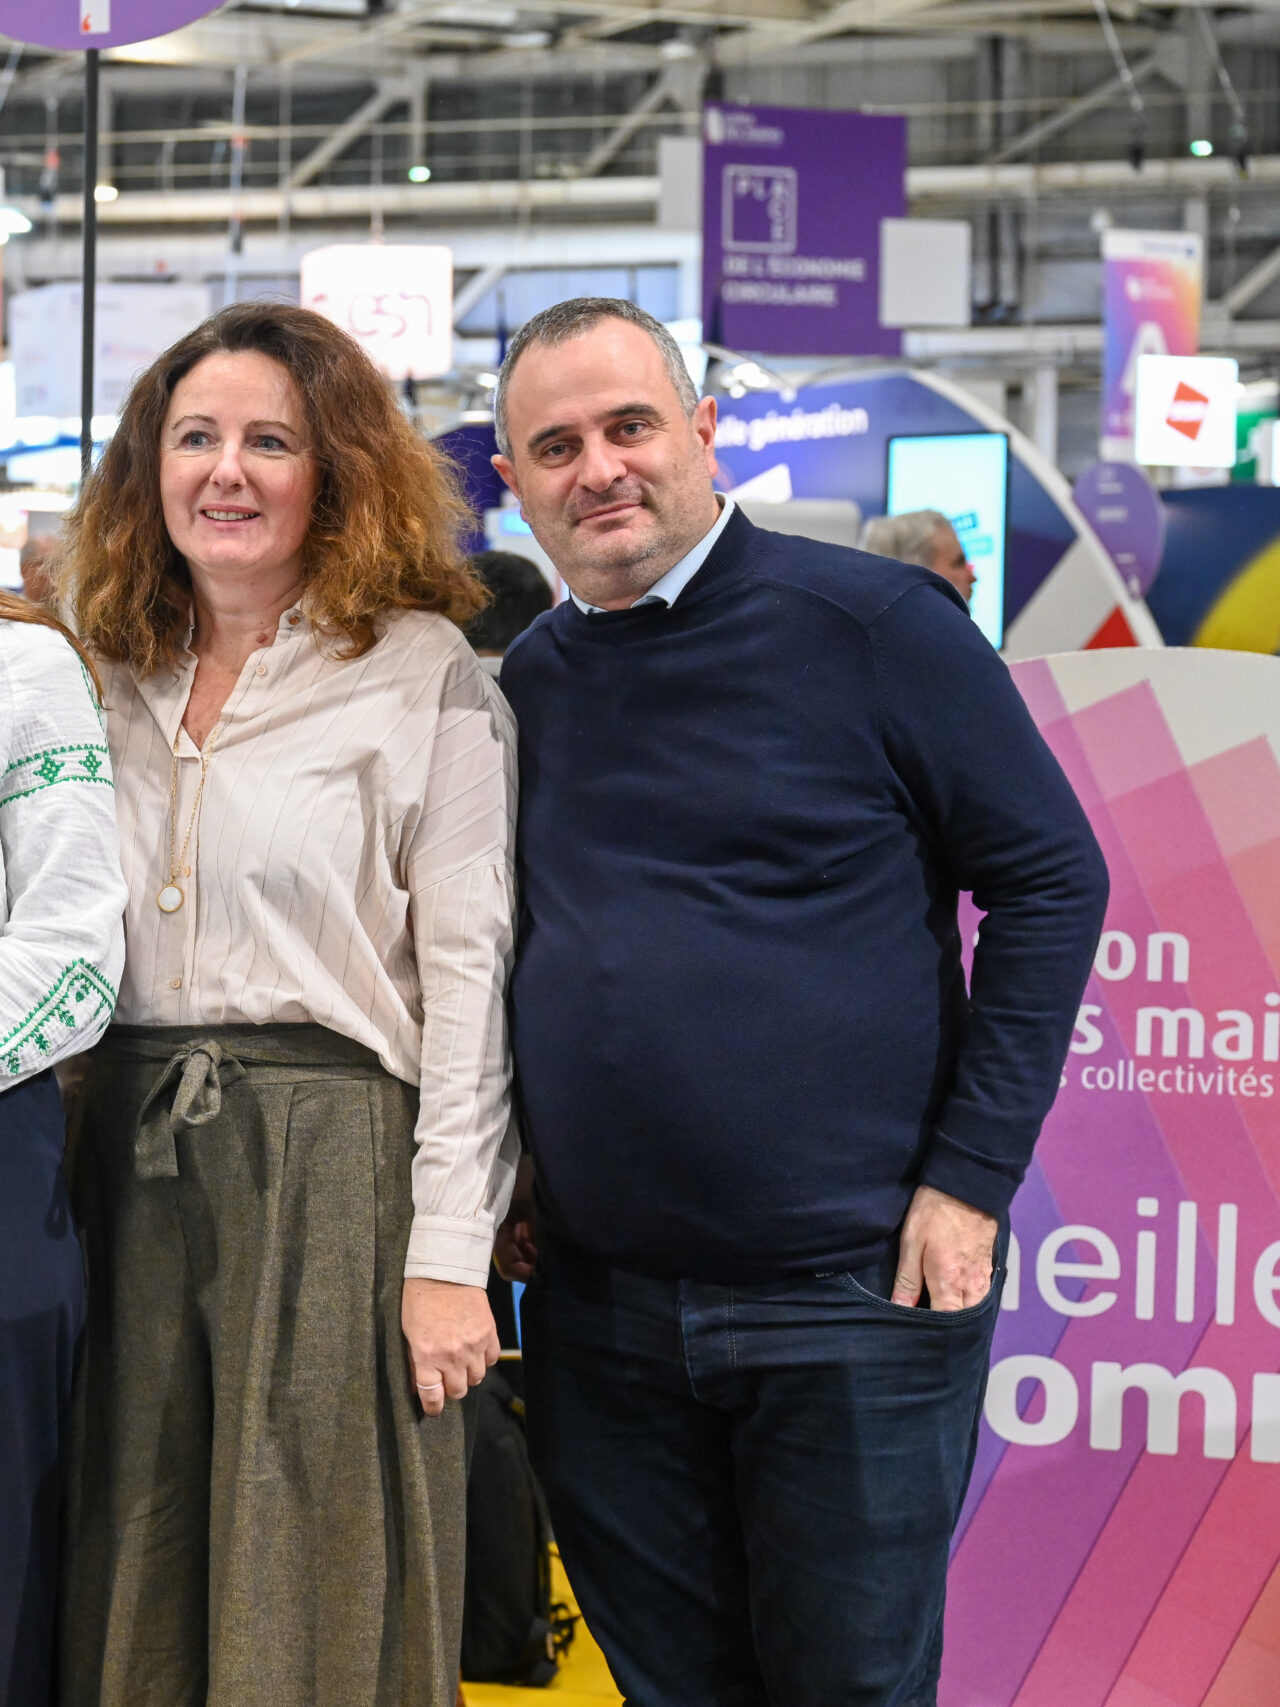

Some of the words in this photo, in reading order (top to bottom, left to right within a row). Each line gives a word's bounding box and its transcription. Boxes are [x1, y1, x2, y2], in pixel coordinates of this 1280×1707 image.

[1094, 930, 1190, 983] on
[1081, 1059, 1274, 1098] collectivités
[1001, 1197, 1280, 1329] eill
[984, 1354, 1280, 1463] om
